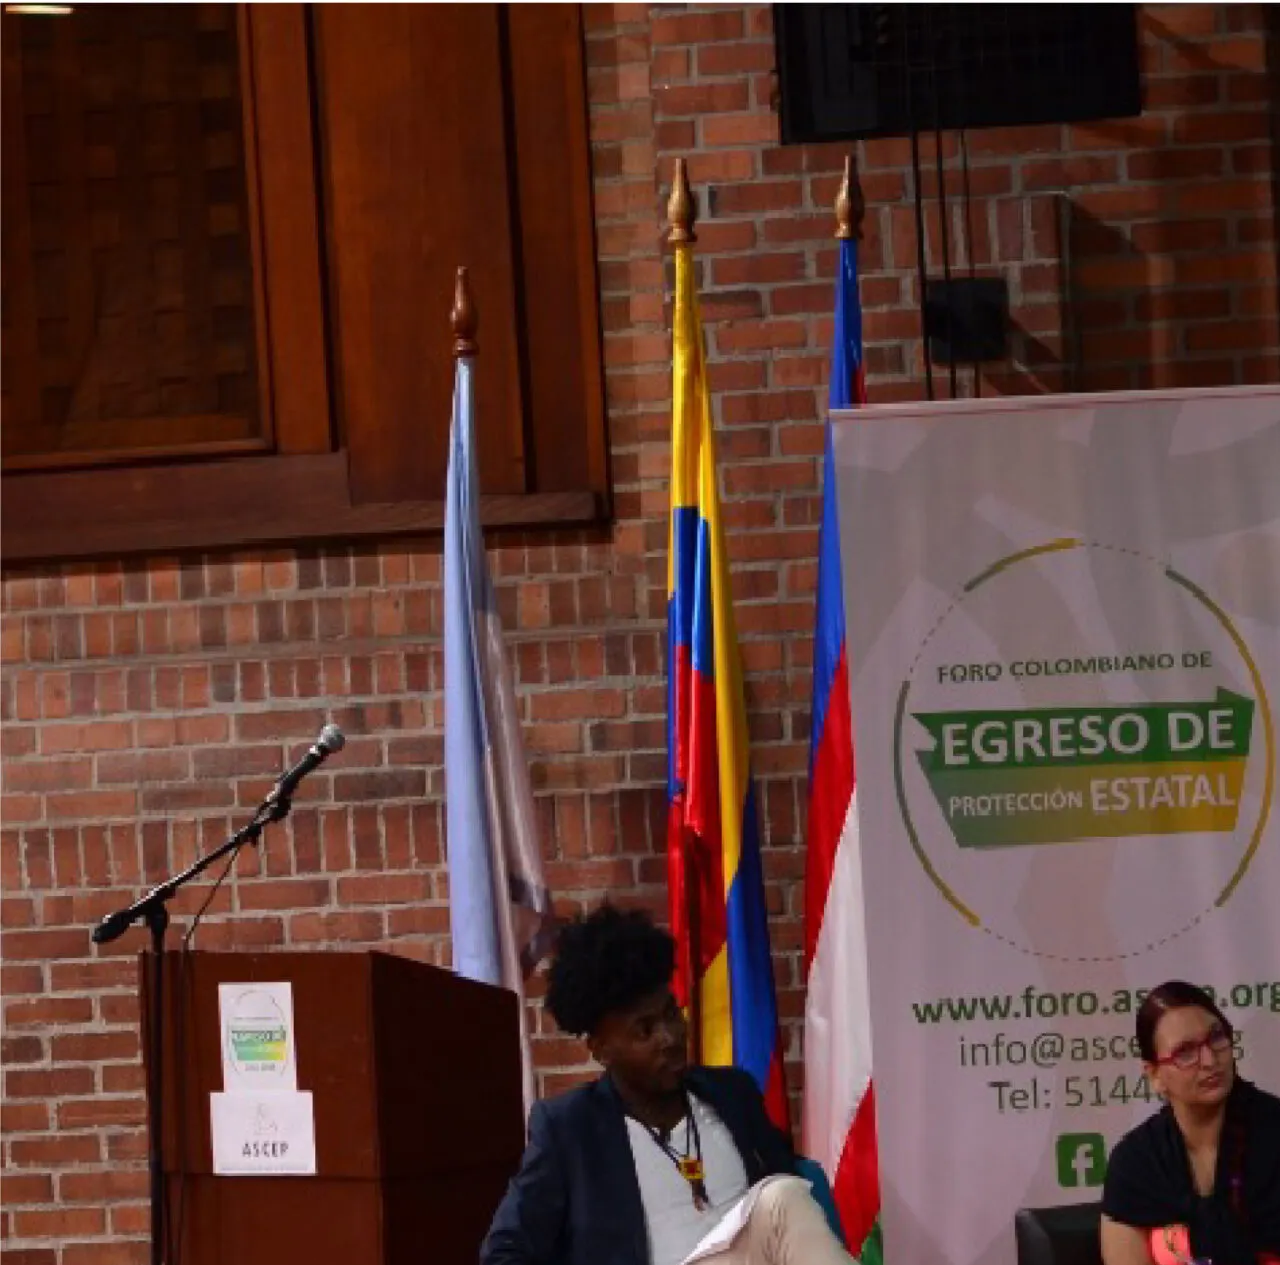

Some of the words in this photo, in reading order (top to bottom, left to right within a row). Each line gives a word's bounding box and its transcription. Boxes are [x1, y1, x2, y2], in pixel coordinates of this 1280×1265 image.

[937, 661, 1003, 684] FORO
[1009, 653, 1175, 678] COLOMBIANO
[1181, 651, 1213, 669] DE
[942, 713, 1149, 766] EGRESO
[1167, 709, 1236, 751] DE
[949, 786, 1083, 817] PROTECCIÓN
[1090, 773, 1236, 812] ESTATAL
[960, 1030, 1245, 1067] info@asceg
[987, 1077, 1051, 1113] Tel:
[1064, 1075, 1168, 1107] 5144
[242, 1140, 290, 1158] ASCEP
